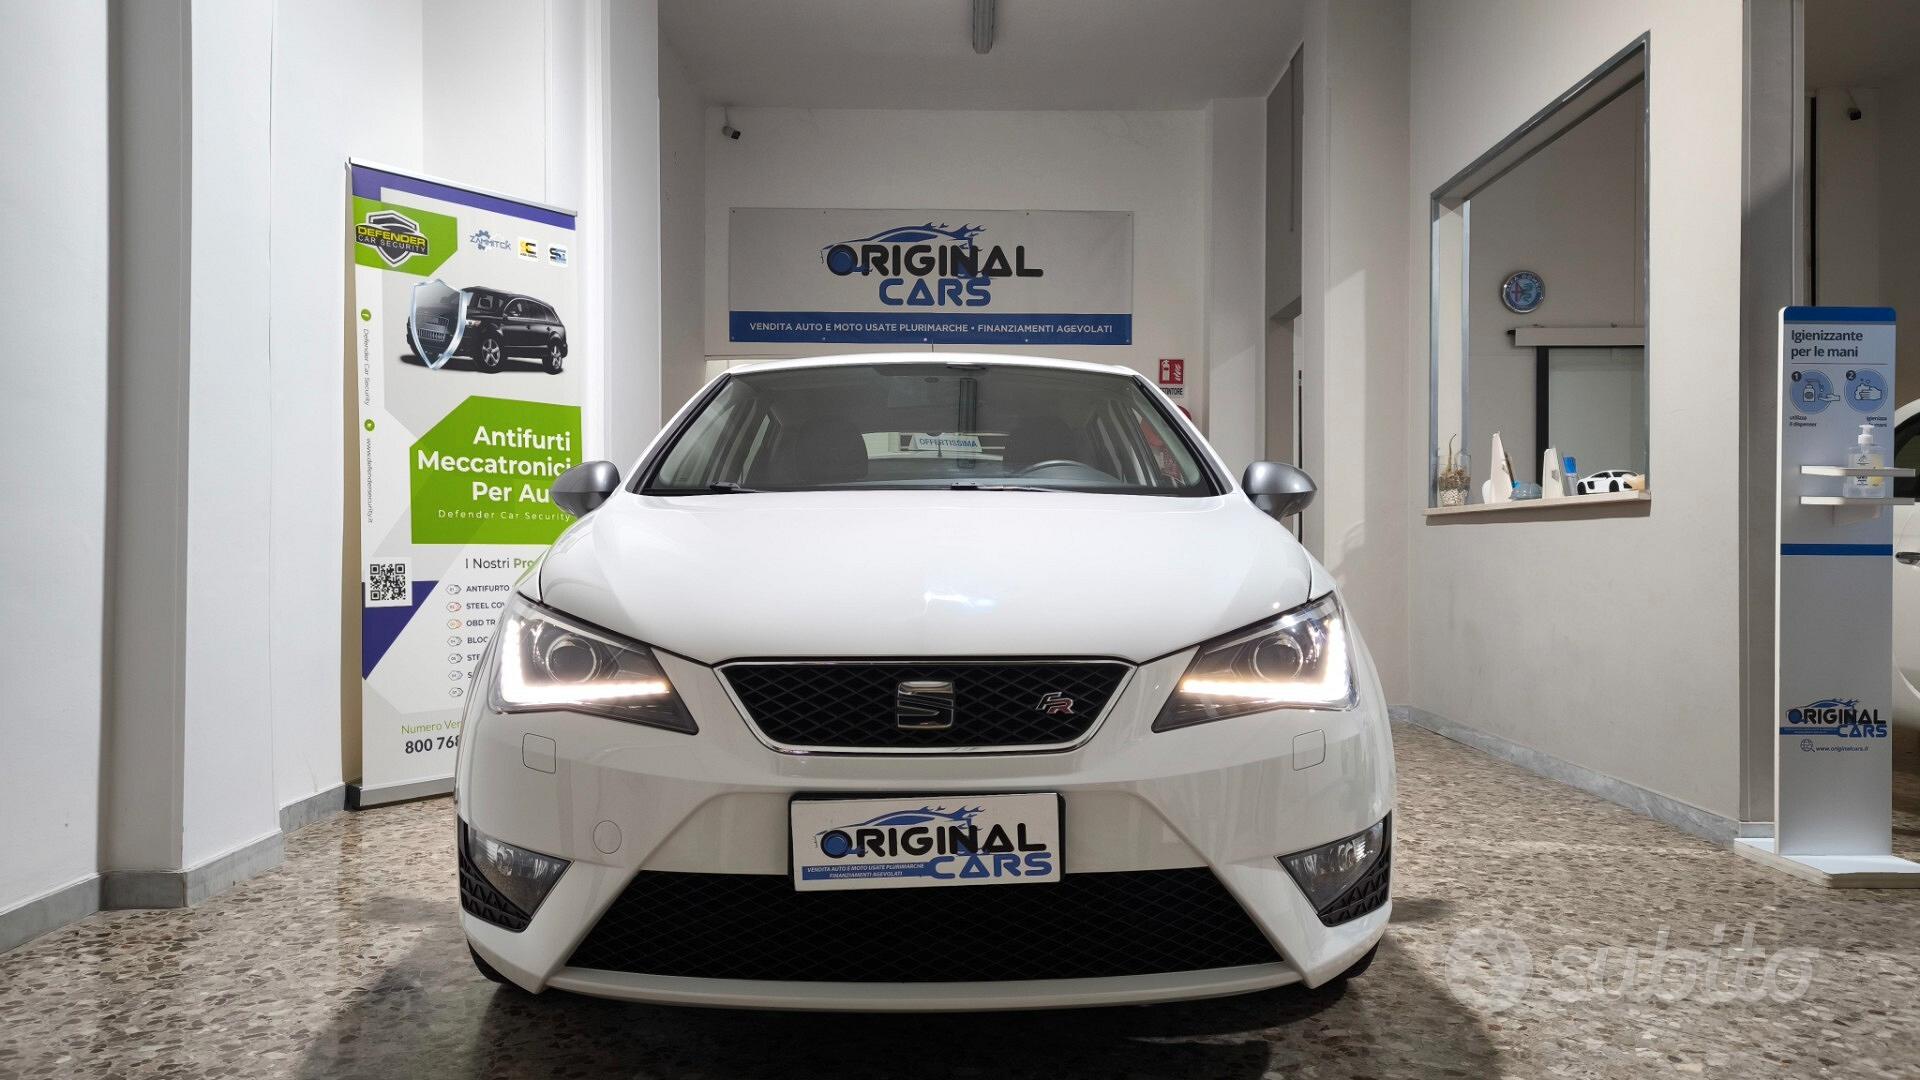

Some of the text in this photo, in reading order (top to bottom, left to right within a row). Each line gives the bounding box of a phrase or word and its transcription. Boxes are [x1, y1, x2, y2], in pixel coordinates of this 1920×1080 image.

[358, 226, 426, 246] DEFENDER
[358, 235, 426, 252] CAR SECURITY
[826, 244, 1044, 277] ORIGINAL
[878, 277, 992, 307] CARS
[750, 322, 1113, 333] VENDITA AUTO E MOTO USATE PLURIMARCHE FINANZIAMENTI AGEVOLATI
[1791, 329, 1864, 343] Igienizzante
[1791, 346, 1858, 359] per le mani
[473, 425, 571, 451] Antifurti
[919, 438, 978, 448] OFFERTISSIMA
[417, 450, 571, 476] Meccatronici
[472, 481, 512, 502] Per
[438, 509, 571, 522] Defender Car Security
[473, 557, 510, 569] Nostri
[466, 602, 489, 610] STEEL
[466, 619, 484, 627] OBD
[1035, 691, 1075, 715] FR
[1787, 708, 1887, 724] ORIGINAL
[401, 723, 442, 734] Numero
[1839, 724, 1888, 738] CARS
[405, 738, 433, 754] 800
[820, 823, 1047, 859] ORIGINAL
[930, 851, 1053, 880] CARS
